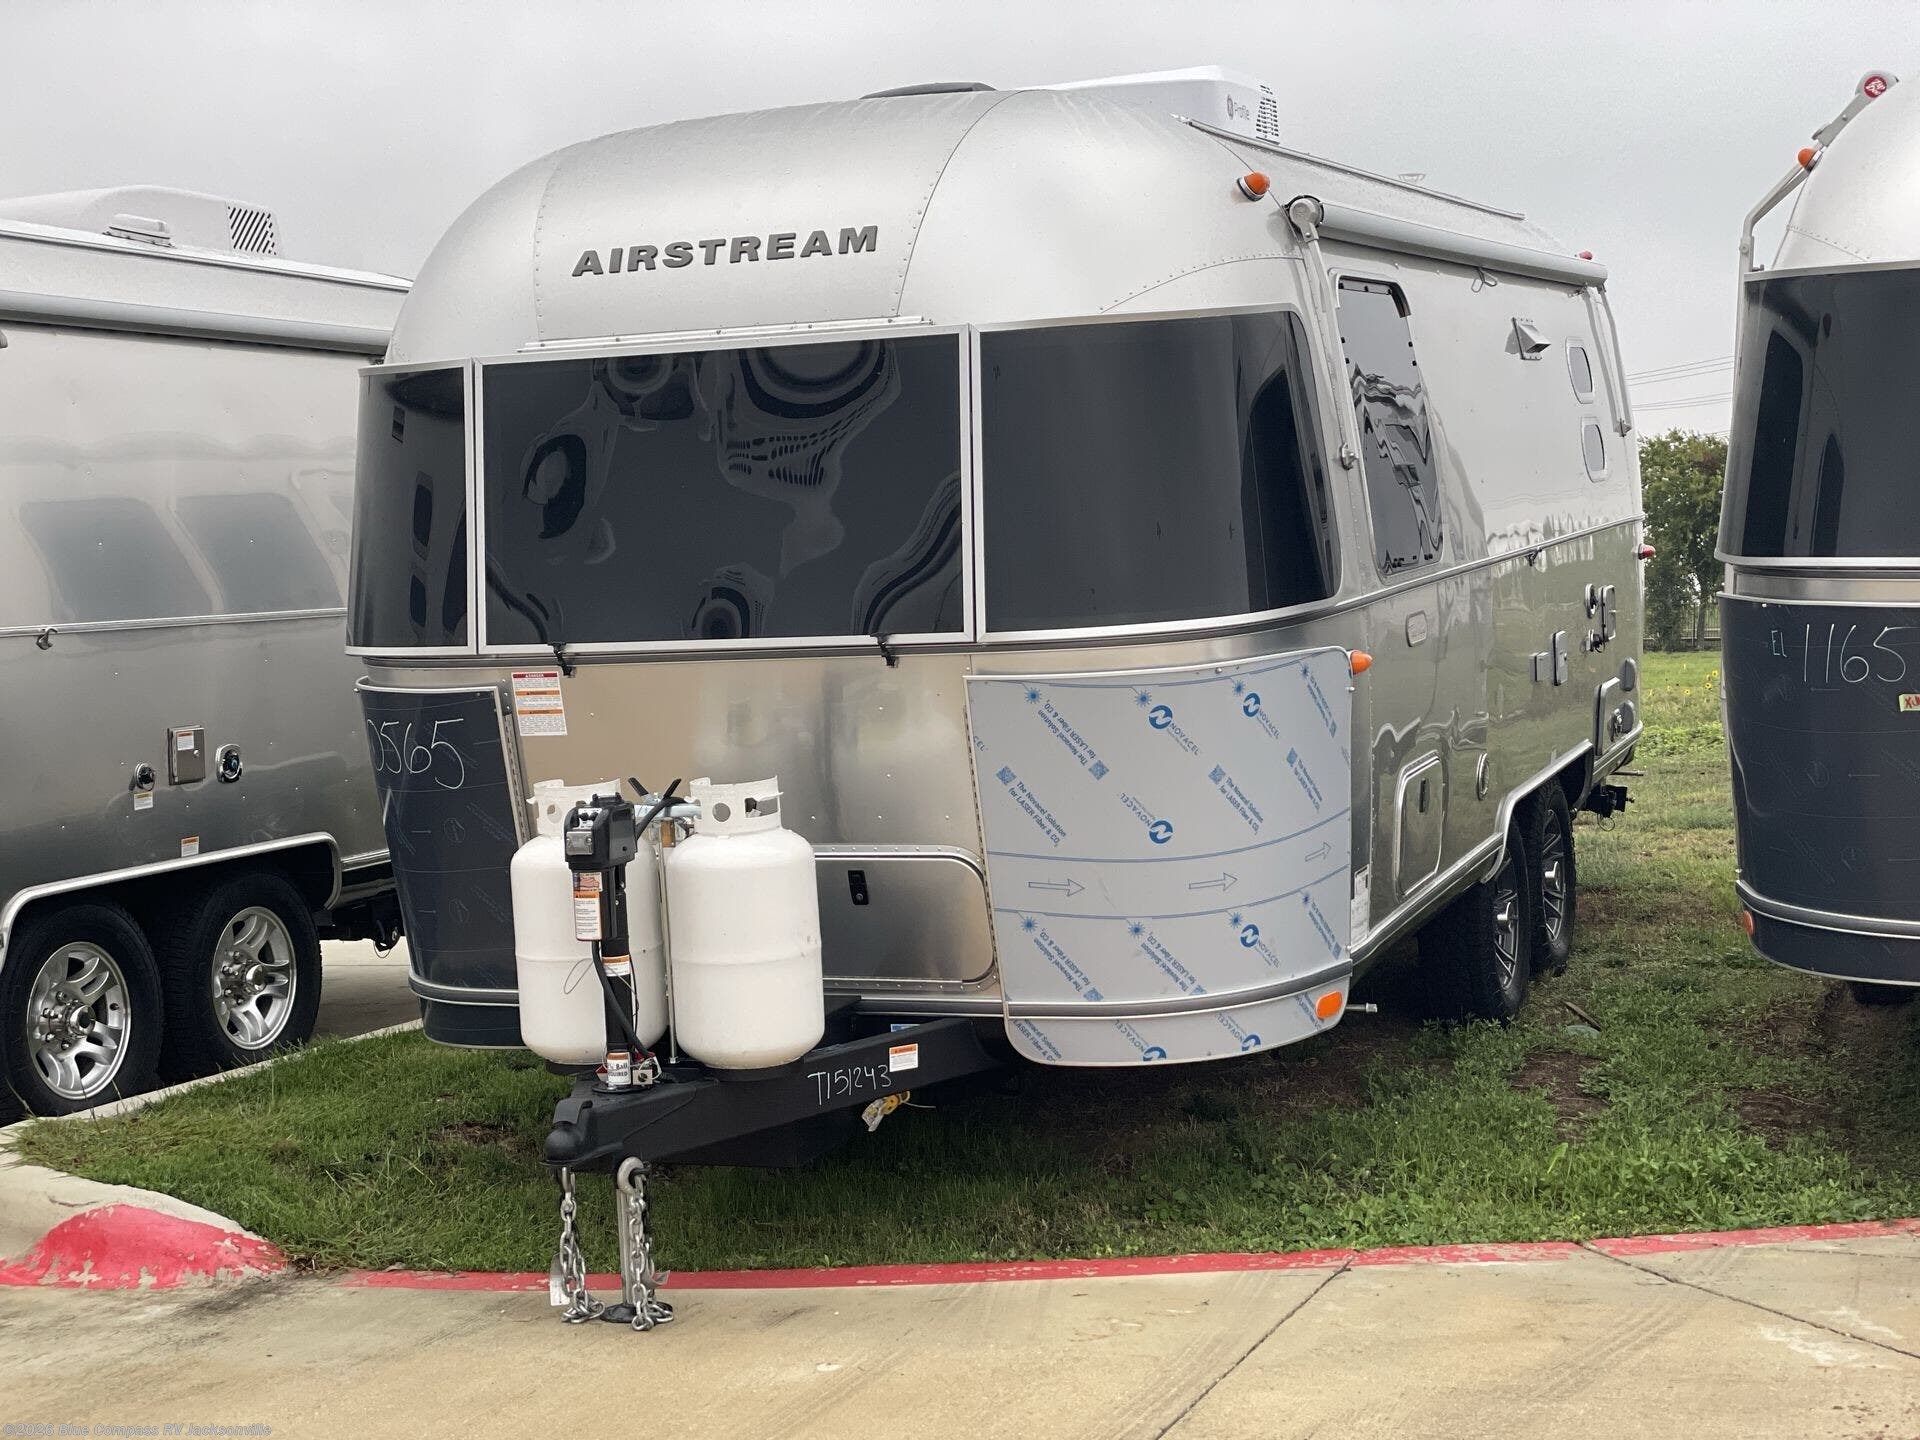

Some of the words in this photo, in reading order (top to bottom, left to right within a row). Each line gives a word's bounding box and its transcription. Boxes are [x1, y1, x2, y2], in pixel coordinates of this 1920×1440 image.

[571, 225, 878, 277] AIRSTREAM
[1803, 623, 1920, 683] 1165
[1038, 710, 1060, 734] Solution
[1057, 716, 1072, 733] Fiber
[1258, 708, 1280, 740] NOVACEL
[1056, 731, 1079, 755] Novacel
[1069, 730, 1089, 751] LASER
[1169, 722, 1200, 756] NOVACEL
[1078, 752, 1088, 766] The
[1087, 748, 1096, 759] for
[1008, 787, 1019, 798] for
[1016, 796, 1036, 816] LASER
[1032, 814, 1047, 830] Fiber
[1017, 781, 1027, 793] The
[1025, 792, 1048, 815] Novacel
[1045, 813, 1066, 837] Solution
[1119, 792, 1151, 827] NOVACEL
[1034, 938, 1055, 961] Solution
[1053, 945, 1068, 960] Fiber
[1141, 942, 1161, 964] Solution
[1160, 947, 1174, 962] Fiber
[1258, 940, 1281, 969] NOVACEL
[1052, 959, 1074, 981] Novacel
[1064, 958, 1083, 977] LASER
[1160, 962, 1181, 983] Novacel
[1171, 959, 1189, 977] LASER
[1073, 980, 1083, 992] The
[1082, 976, 1091, 986] for
[1179, 980, 1189, 992] The
[1188, 974, 1196, 985] for
